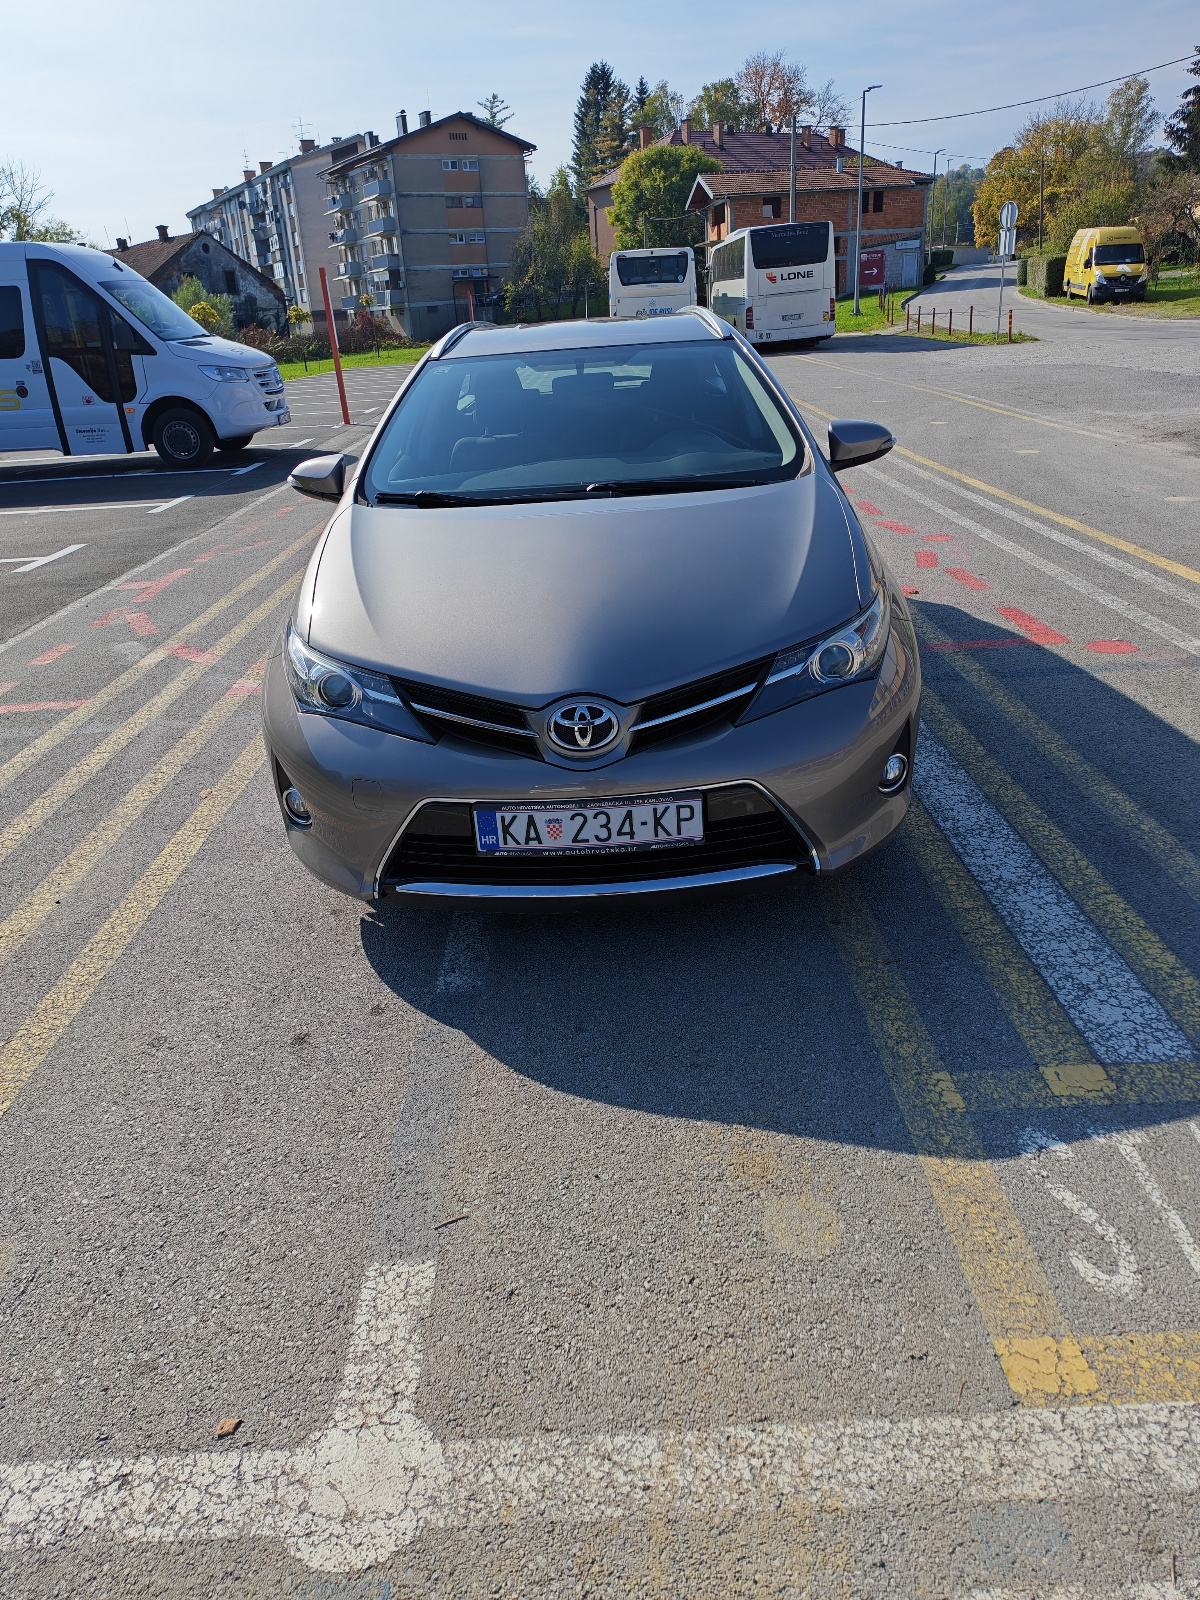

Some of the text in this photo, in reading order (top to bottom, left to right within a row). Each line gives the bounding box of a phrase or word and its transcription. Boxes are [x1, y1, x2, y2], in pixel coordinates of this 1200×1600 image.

[780, 270, 814, 281] LONE
[500, 804, 696, 846] KA 234-KP
[481, 835, 496, 845] HR
[542, 846, 638, 857] www.autohrvatska.hr
